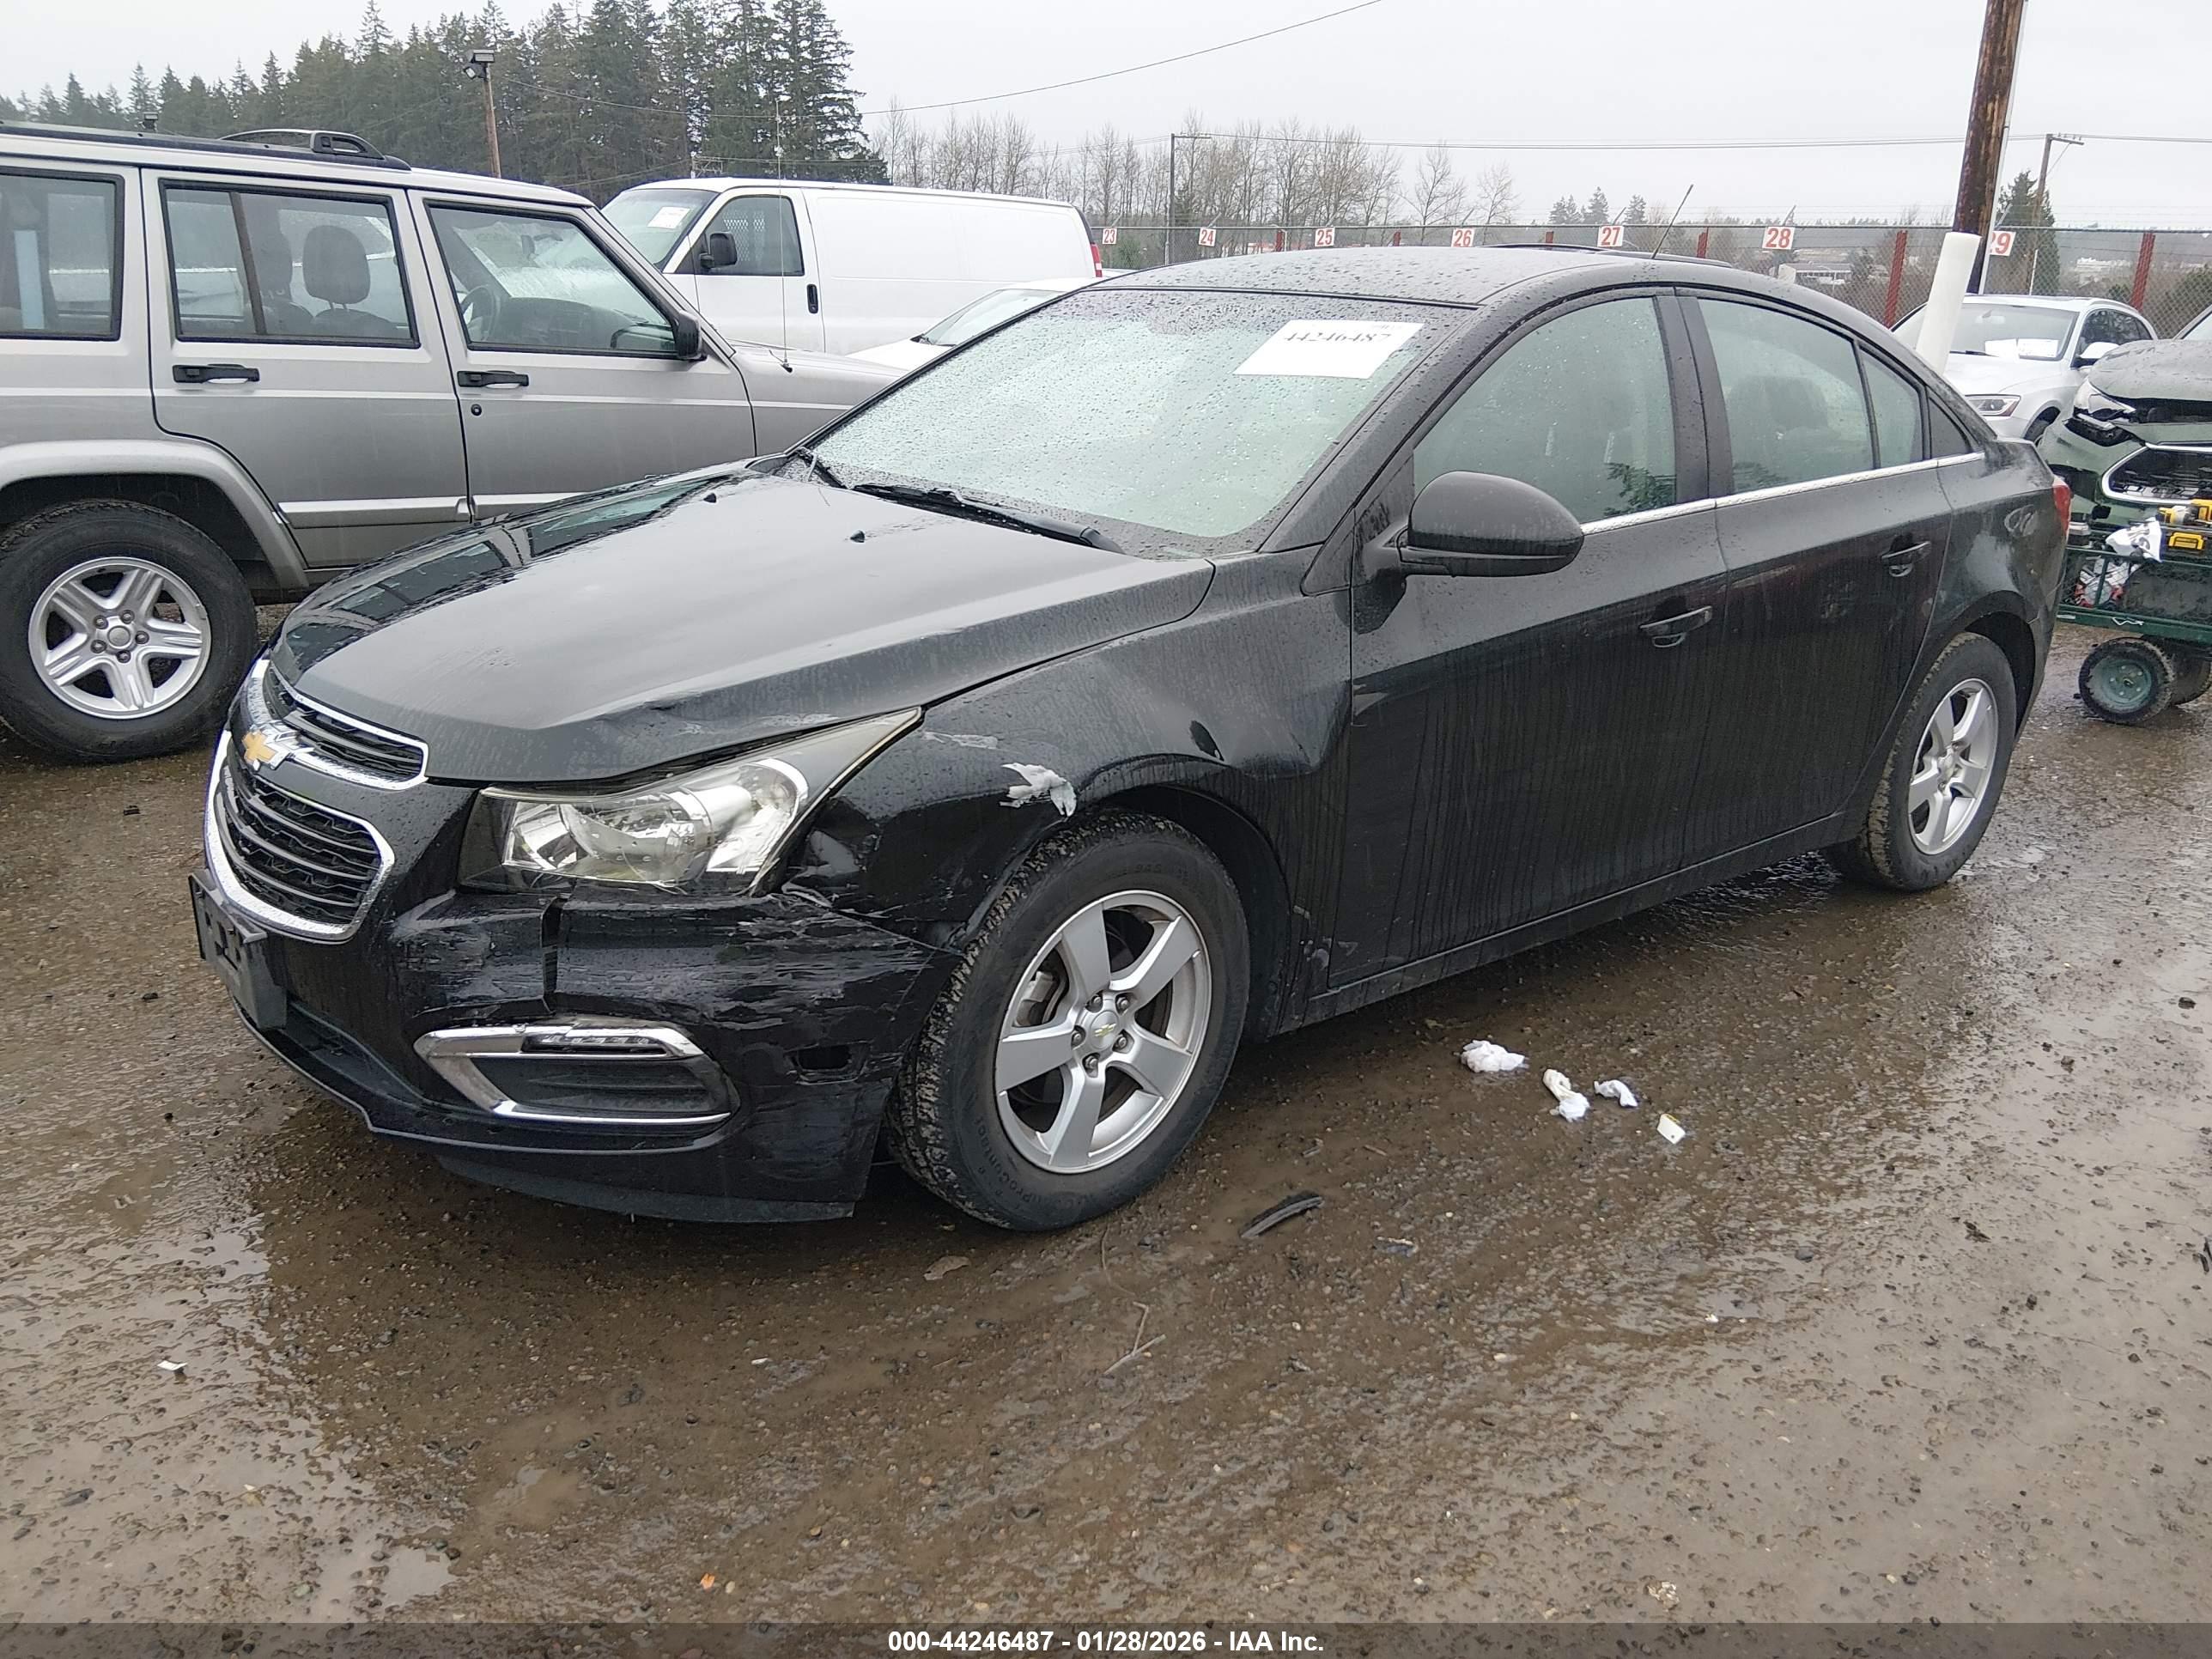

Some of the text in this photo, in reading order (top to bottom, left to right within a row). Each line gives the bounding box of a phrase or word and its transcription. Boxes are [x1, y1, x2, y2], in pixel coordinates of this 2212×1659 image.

[1103, 228, 1115, 244] 23
[1201, 229, 1214, 245] 24
[1317, 229, 1333, 246] 25
[1454, 229, 1472, 247] 26
[1601, 227, 1621, 246] 27
[1765, 228, 1791, 248] 28
[1990, 231, 2011, 254] 9
